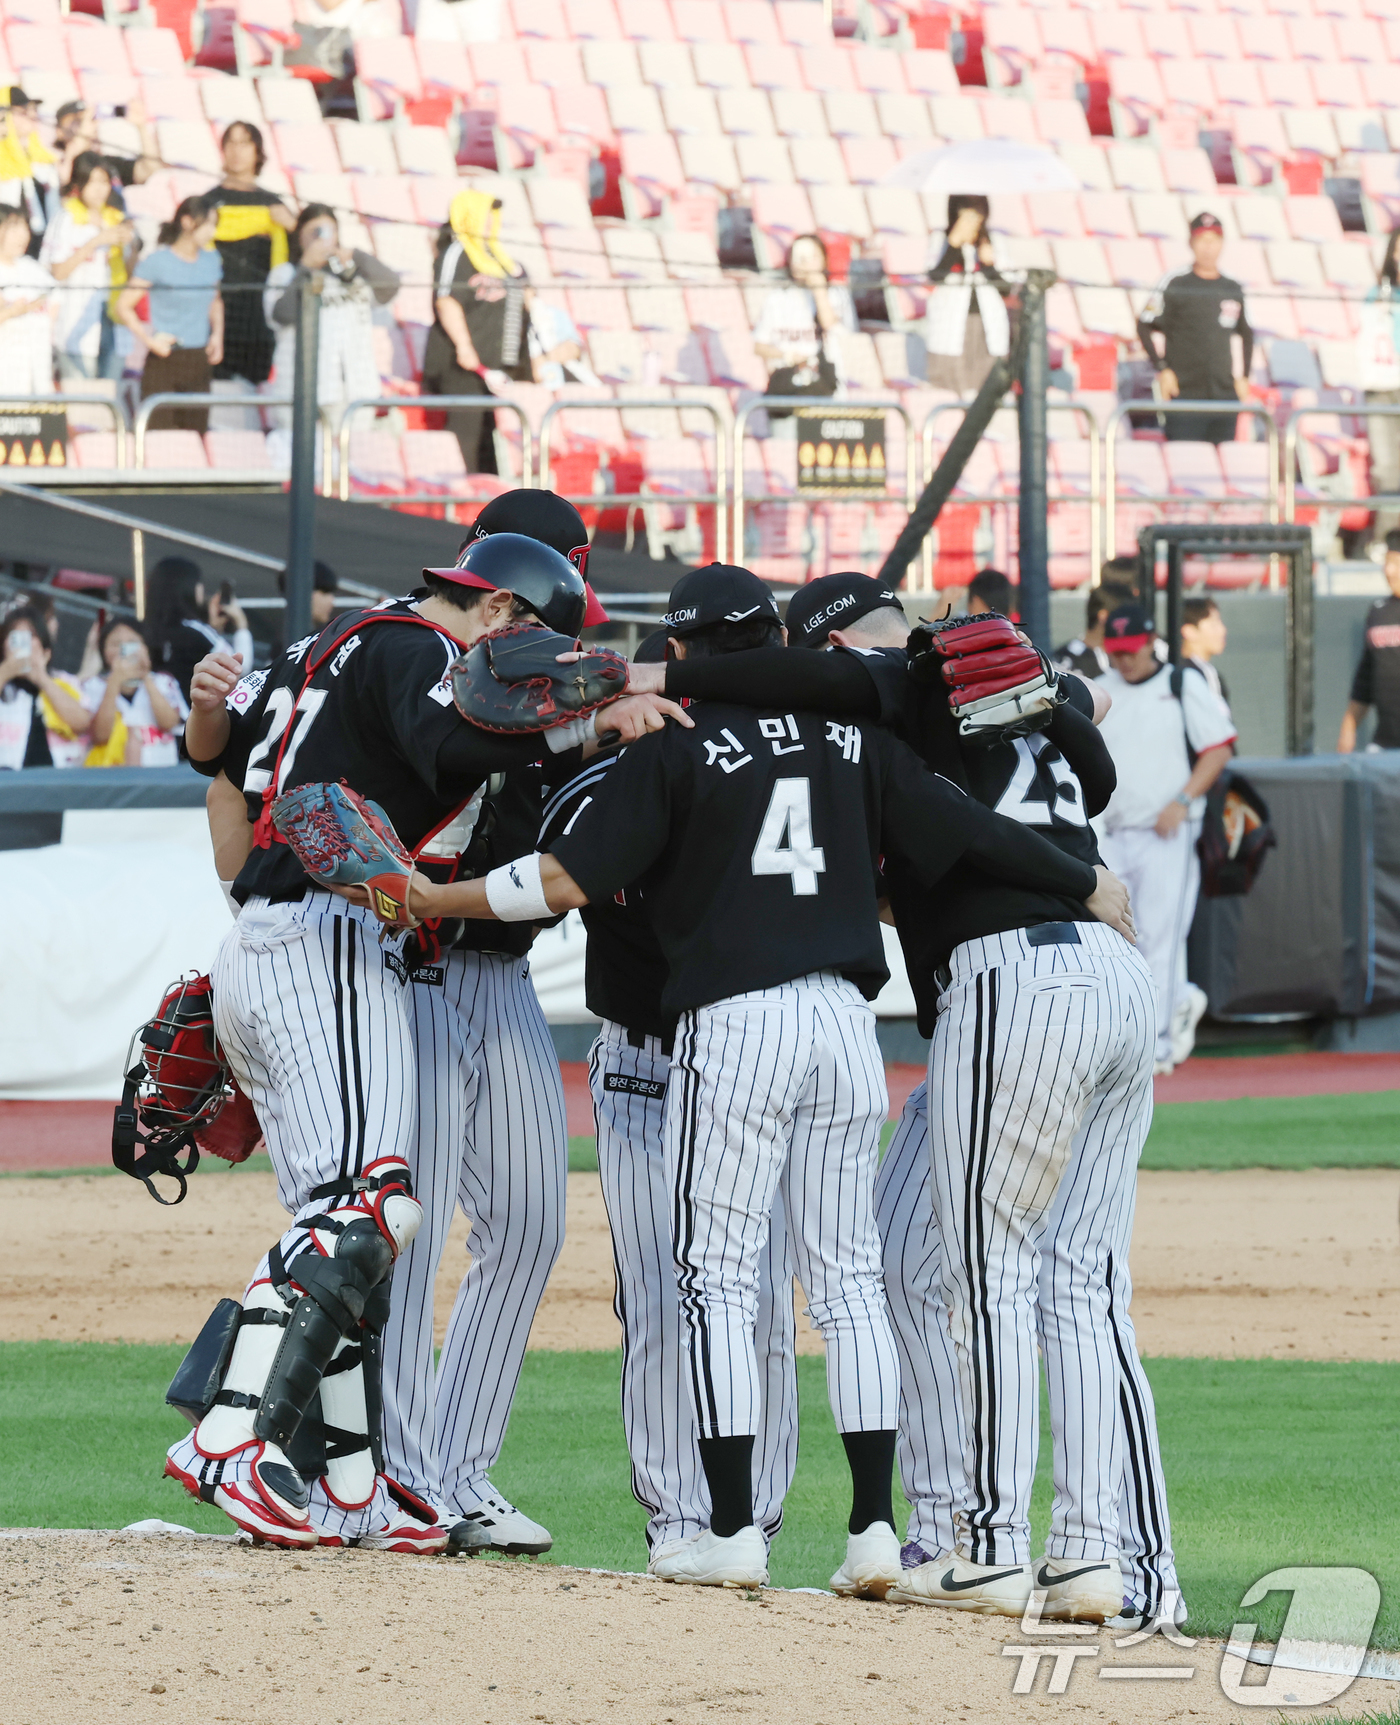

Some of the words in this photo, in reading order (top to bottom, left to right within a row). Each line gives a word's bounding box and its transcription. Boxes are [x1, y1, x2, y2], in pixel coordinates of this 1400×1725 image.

[802, 594, 857, 634] LGE.COM
[243, 685, 330, 797] 27
[702, 713, 862, 774] 신민재
[751, 777, 827, 896] 4
[609, 1076, 628, 1089] 영진
[629, 1079, 660, 1095] 구론산
